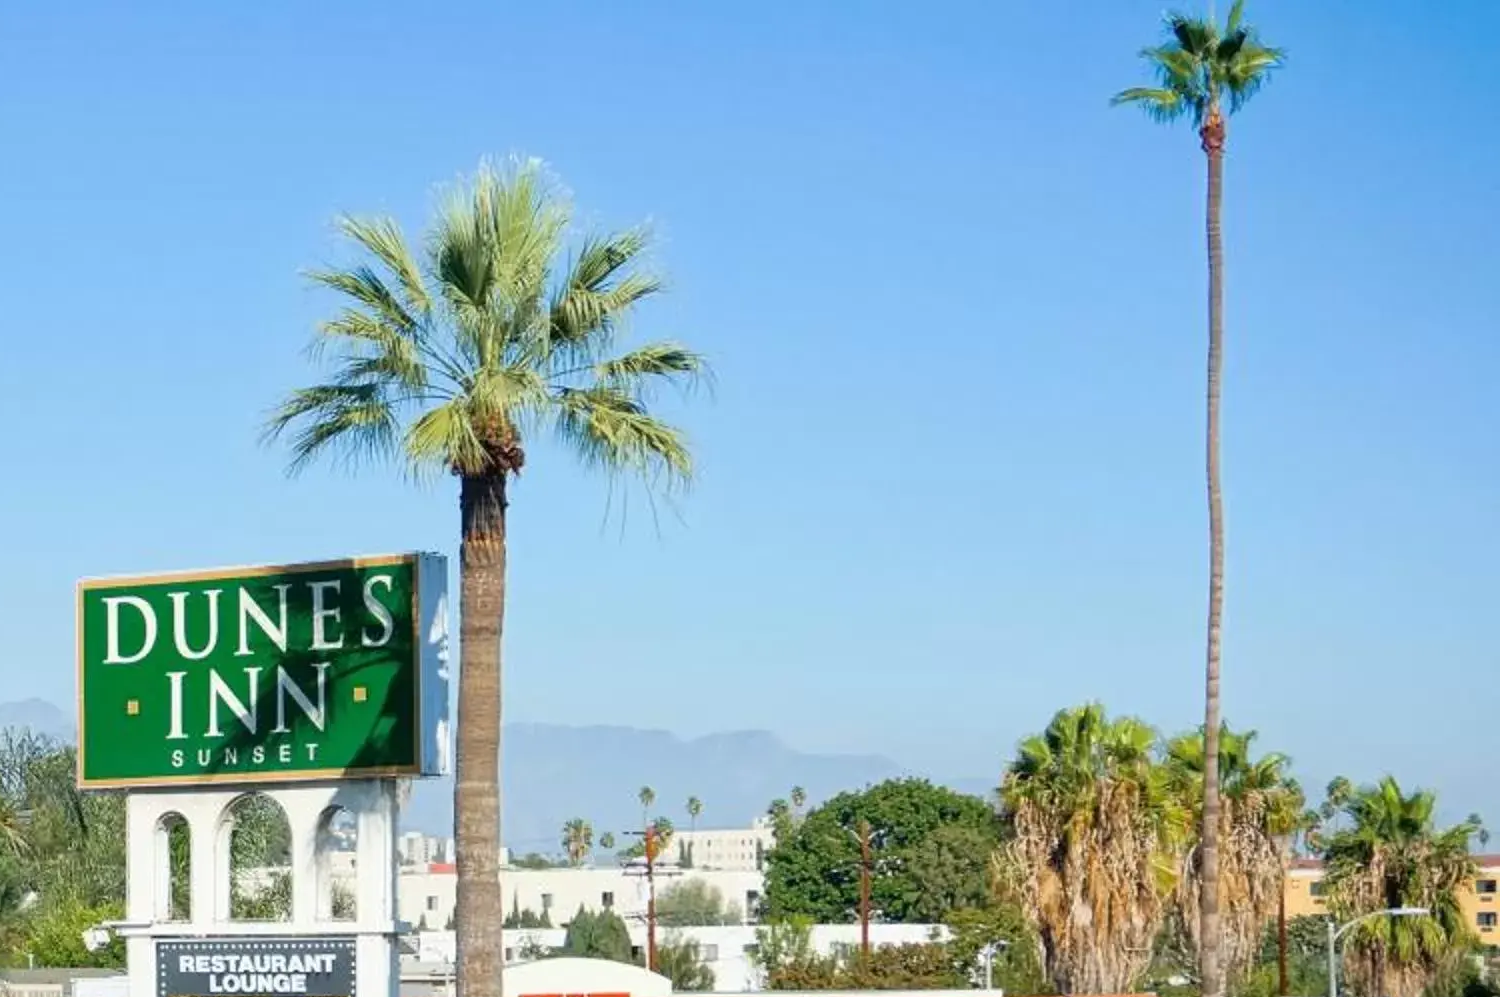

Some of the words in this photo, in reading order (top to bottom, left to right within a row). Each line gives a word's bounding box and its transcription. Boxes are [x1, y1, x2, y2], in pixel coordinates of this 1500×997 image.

[101, 574, 395, 665] DUNES
[165, 662, 331, 740] INN
[171, 743, 320, 768] SUNSET
[178, 954, 337, 974] RESTAURANT
[208, 974, 308, 993] LOUNGE
